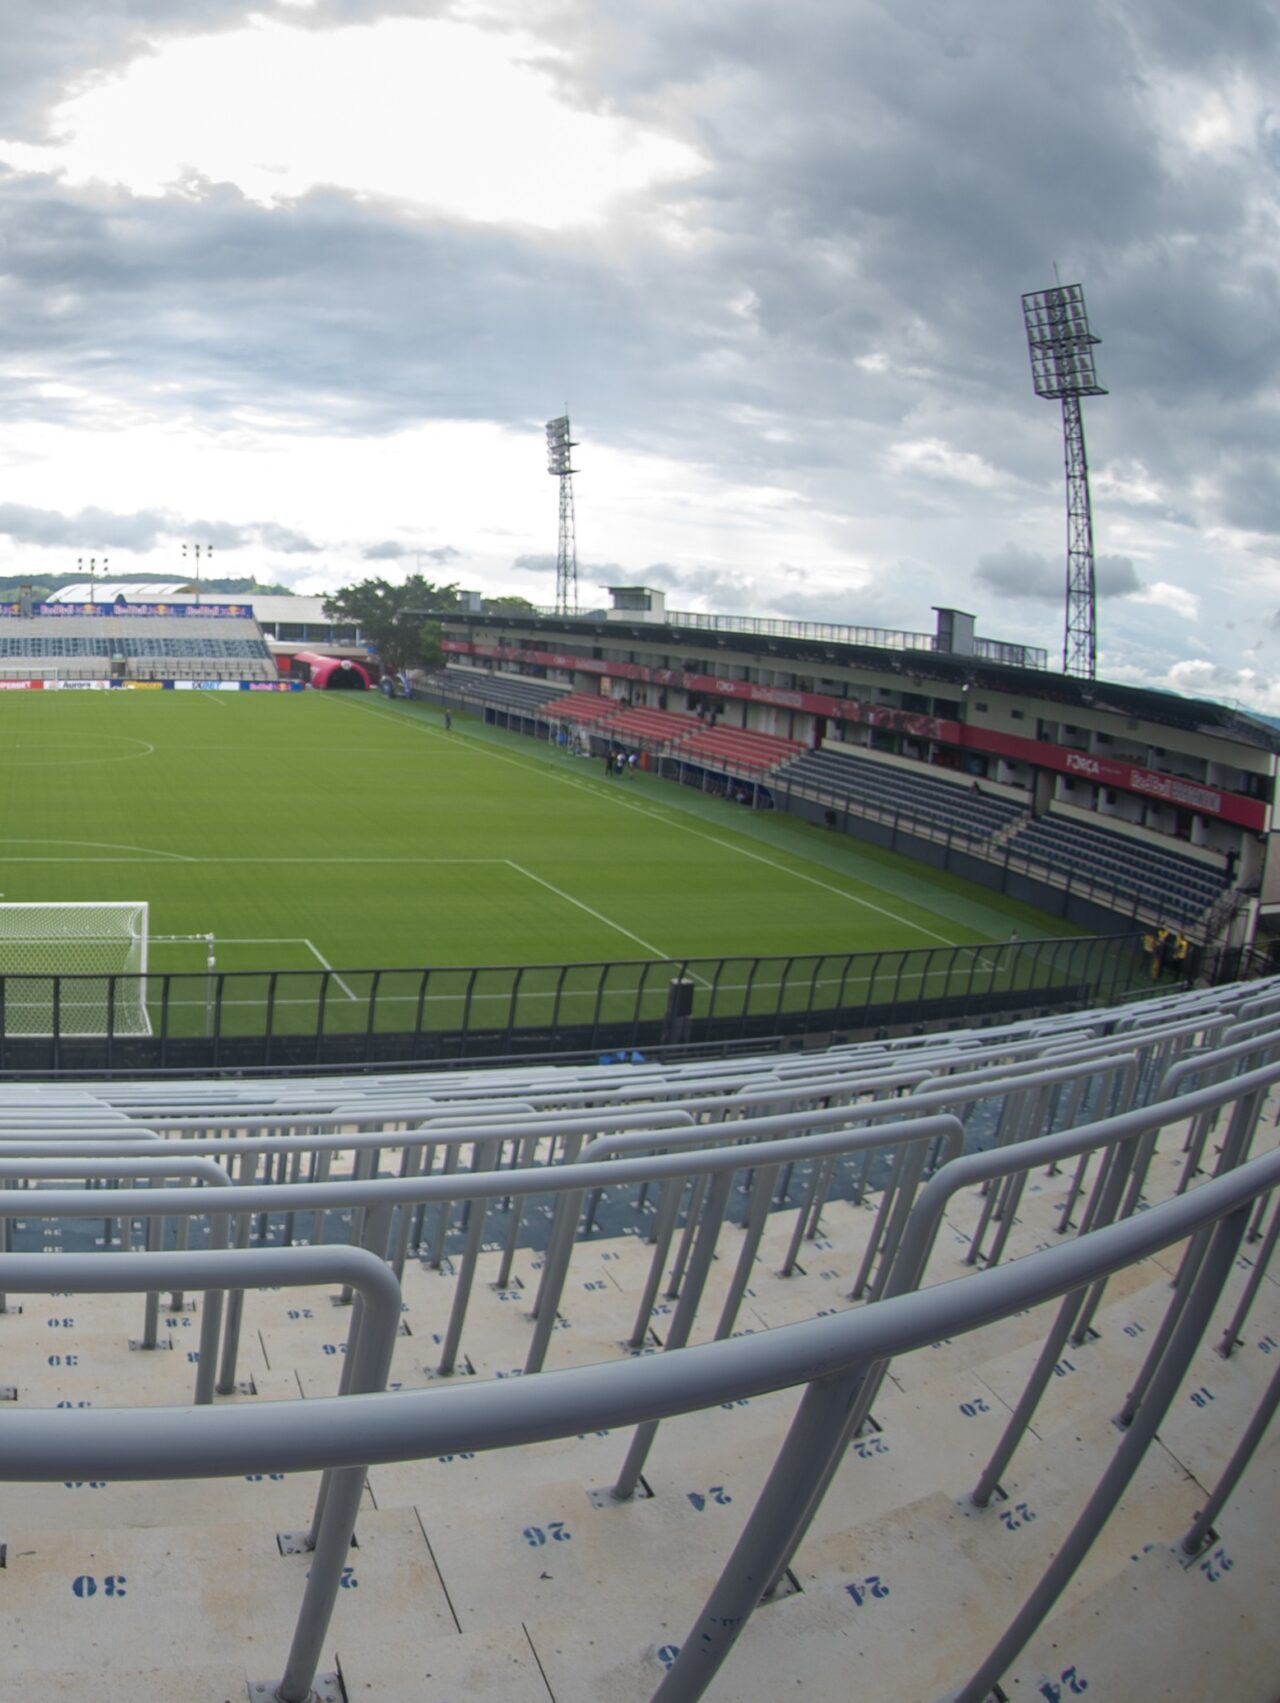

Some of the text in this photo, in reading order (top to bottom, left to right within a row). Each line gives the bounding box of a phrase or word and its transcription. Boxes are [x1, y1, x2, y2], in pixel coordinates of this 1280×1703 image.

[1067, 754, 1100, 774] FORÇA
[47, 1317, 76, 1329] 30
[287, 1309, 313, 1320] 26
[47, 1354, 77, 1368] 30
[959, 1397, 991, 1418] 20
[852, 1437, 890, 1460] 22
[1000, 1502, 1039, 1533] 22
[521, 1521, 572, 1548] 26
[1201, 1547, 1234, 1583] 22
[72, 1575, 126, 1600] 30
[846, 1575, 892, 1606] 24
